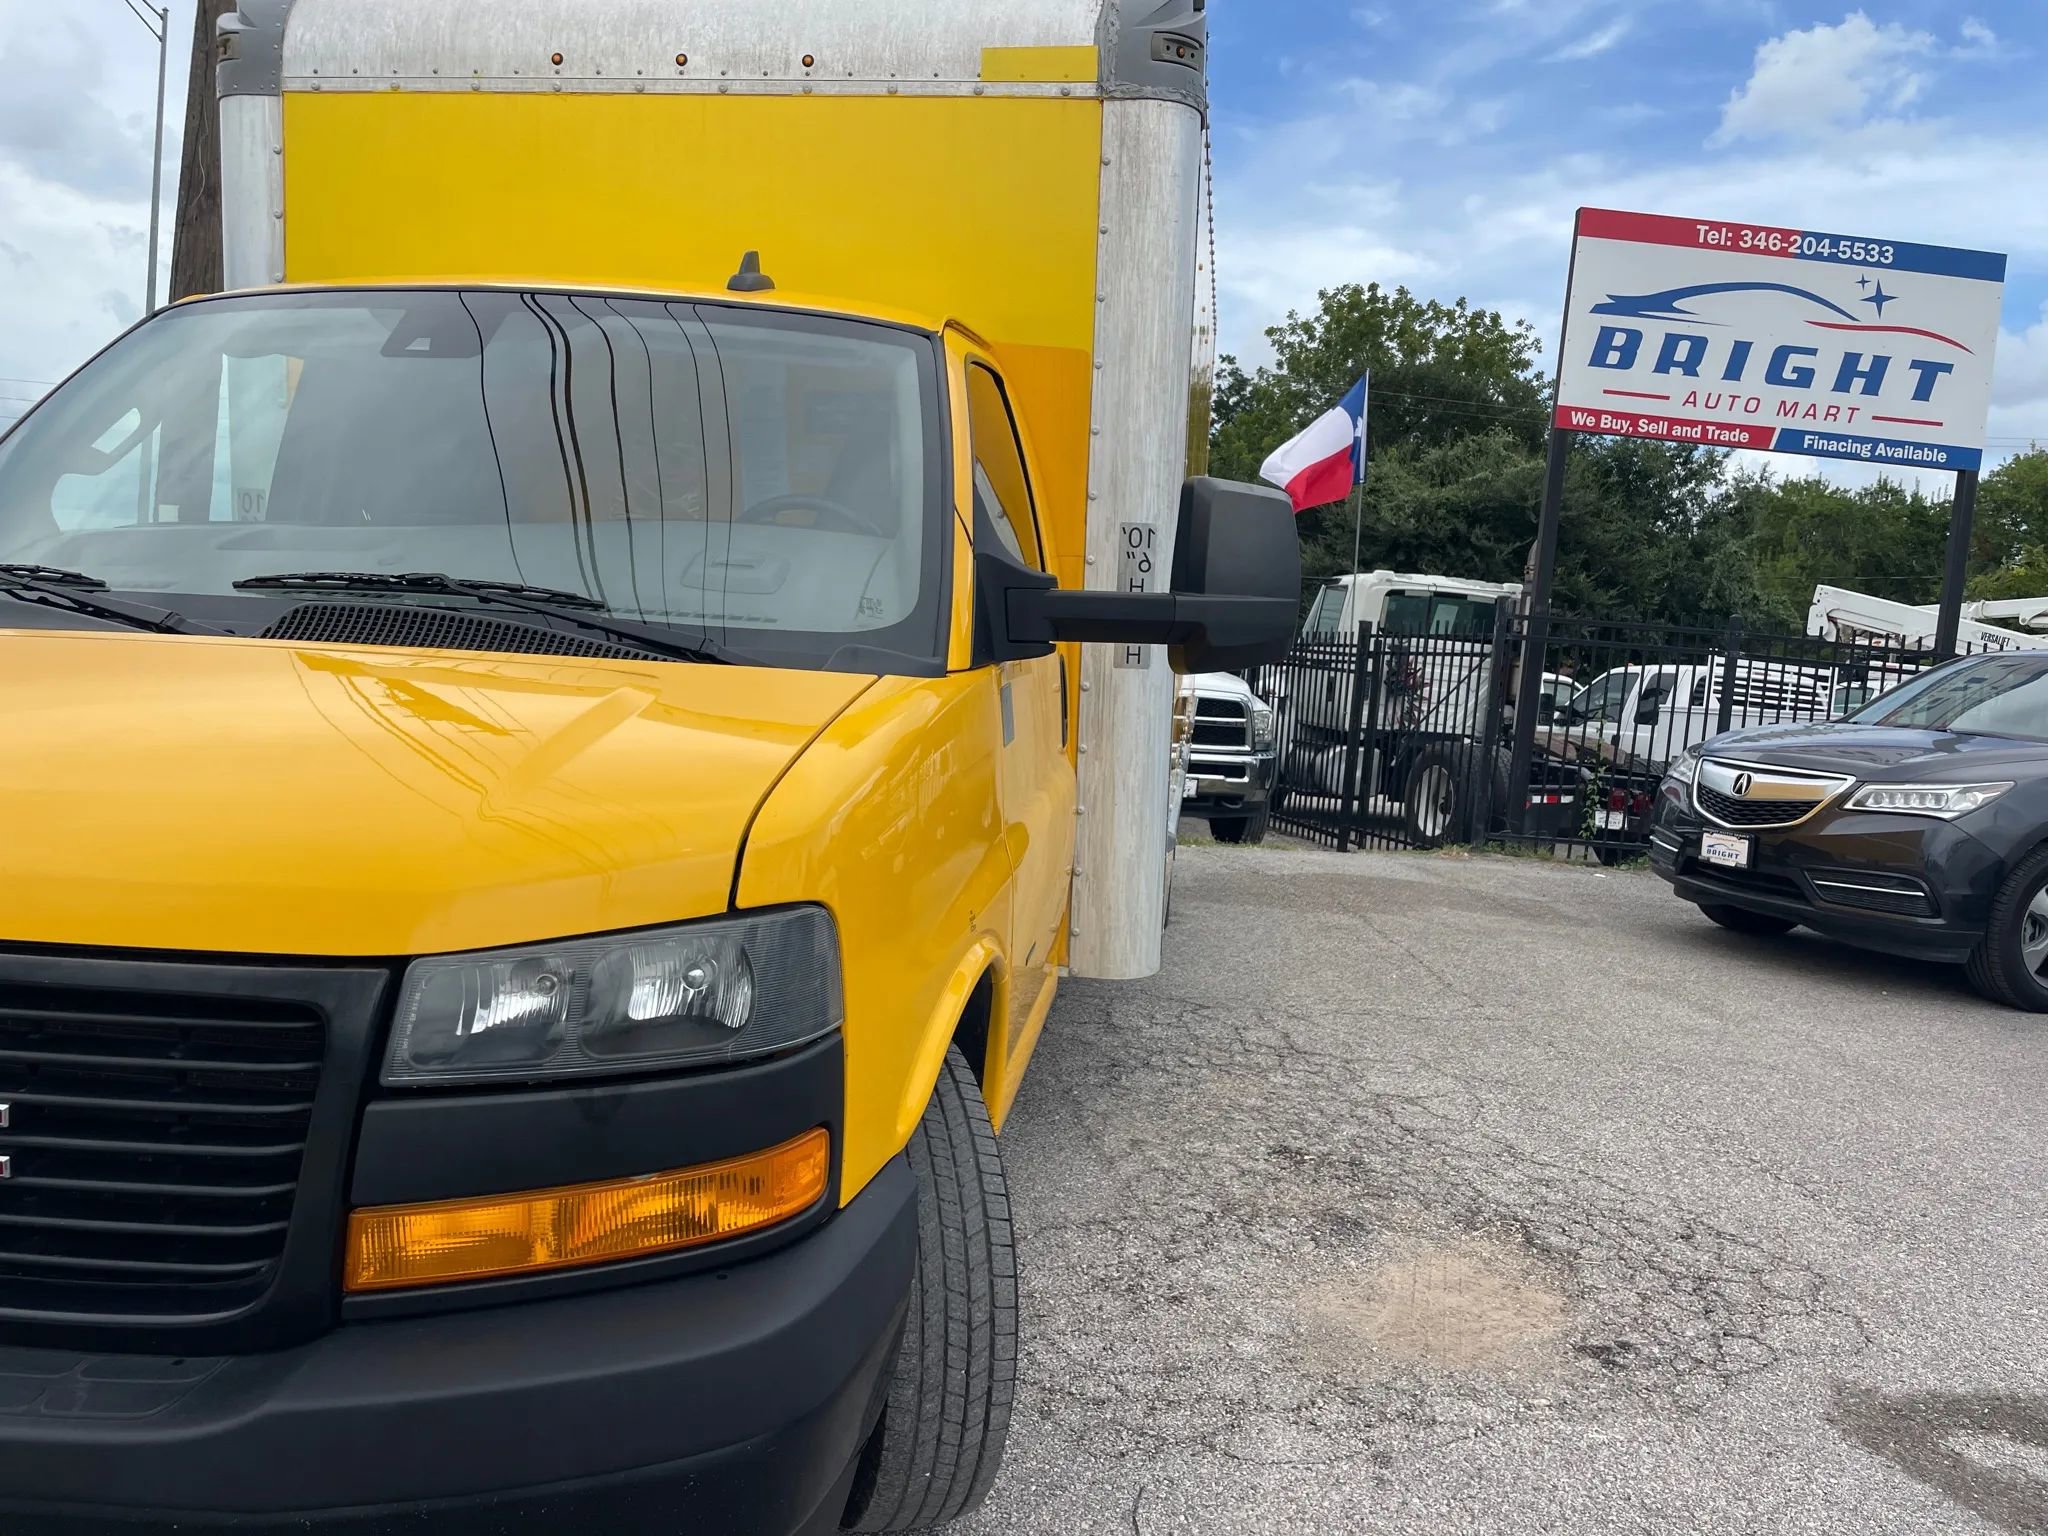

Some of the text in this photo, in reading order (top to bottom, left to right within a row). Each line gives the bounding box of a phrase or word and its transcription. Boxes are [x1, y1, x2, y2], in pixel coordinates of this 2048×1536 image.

[1696, 224, 1894, 264] Tel: 346-204-5533
[1587, 325, 1955, 402] BRIGHT
[1682, 390, 1860, 423] AUTO MART
[1571, 411, 1750, 443] We Buy, Sell and Trade
[1803, 434, 1948, 463] Finacing Available
[1981, 632, 2010, 646] VERSALIFT
[1707, 849, 1740, 859] BRIGHT
